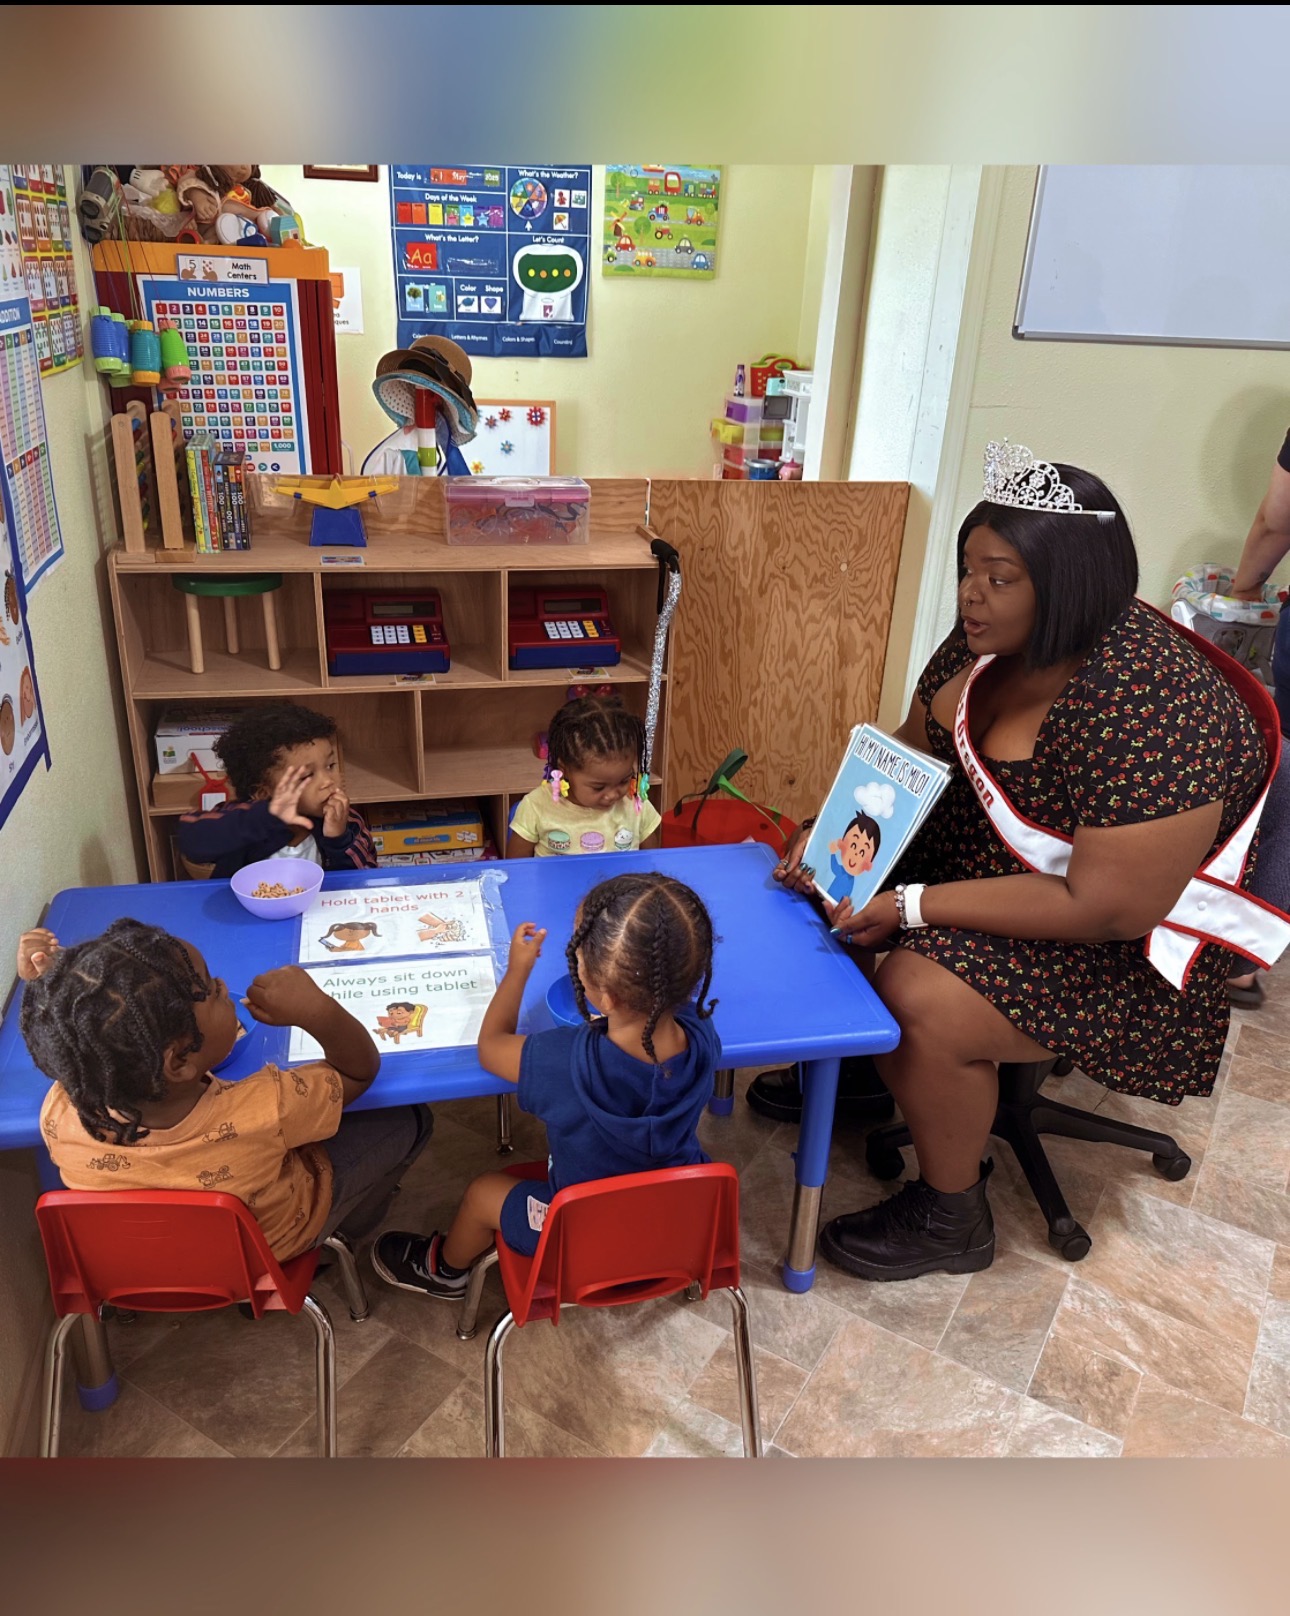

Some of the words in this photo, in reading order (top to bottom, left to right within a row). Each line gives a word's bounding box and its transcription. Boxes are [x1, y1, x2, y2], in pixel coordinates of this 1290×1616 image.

[396, 172, 414, 180] Today
[416, 172, 421, 180] is
[518, 169, 539, 178] What's
[425, 192, 440, 202] Days
[424, 233, 446, 241] What's
[411, 248, 432, 264] Aa
[227, 272, 257, 280] Centers
[187, 286, 250, 298] NUMBERS
[485, 285, 504, 293] Shape
[862, 739, 880, 763] MY
[874, 746, 901, 778] NAME
[896, 760, 910, 783] IS
[904, 766, 930, 796] MILO!
[321, 898, 357, 907] Hold
[364, 894, 410, 904] tablet
[416, 892, 449, 901] with
[370, 904, 419, 914] hands
[323, 975, 387, 988] Always
[394, 972, 415, 982] sit
[422, 968, 467, 980] down
[331, 990, 363, 1000] hile
[371, 985, 419, 998] using
[426, 980, 478, 992] tablet
